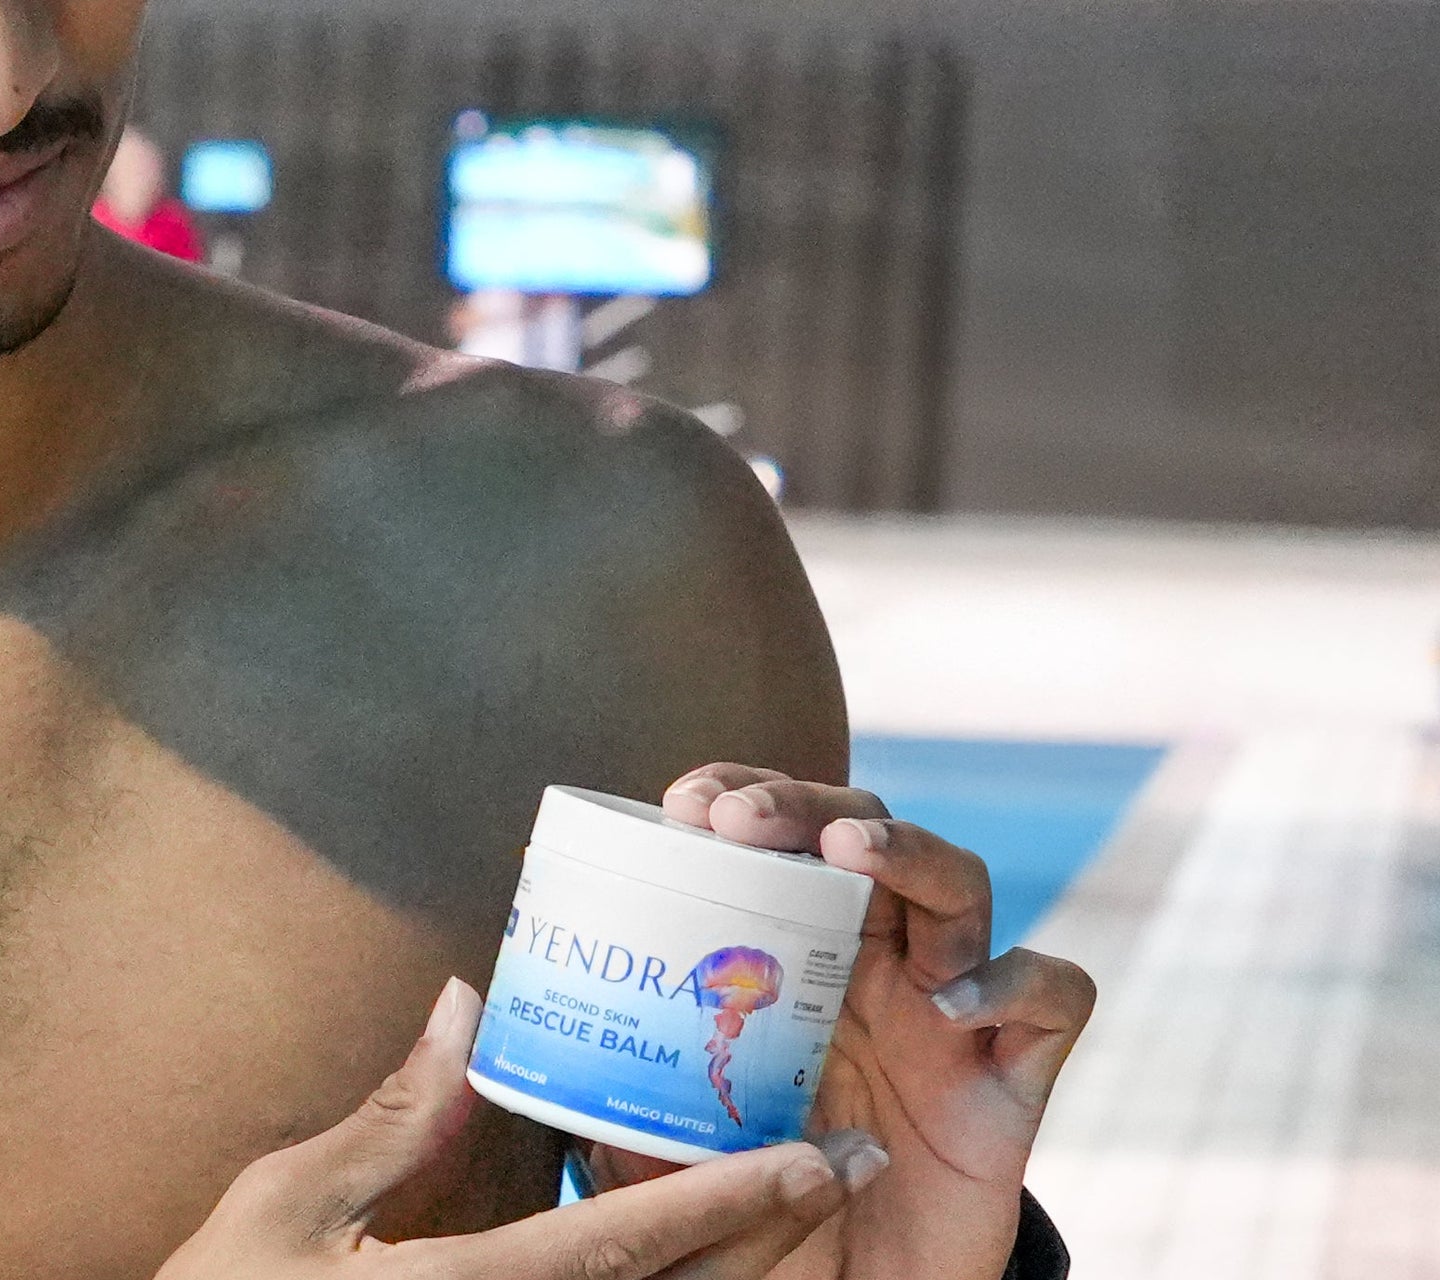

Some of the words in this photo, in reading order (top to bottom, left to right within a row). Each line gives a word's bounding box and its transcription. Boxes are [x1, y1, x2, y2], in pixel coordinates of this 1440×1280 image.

[529, 916, 702, 1007] YENDRA
[509, 996, 593, 1043] RESCUE
[600, 1028, 681, 1069] BALM
[544, 989, 600, 1017] SECOND
[603, 1009, 640, 1030] SKIN
[606, 1096, 660, 1122] MANGO
[663, 1111, 717, 1136] BUTTER
